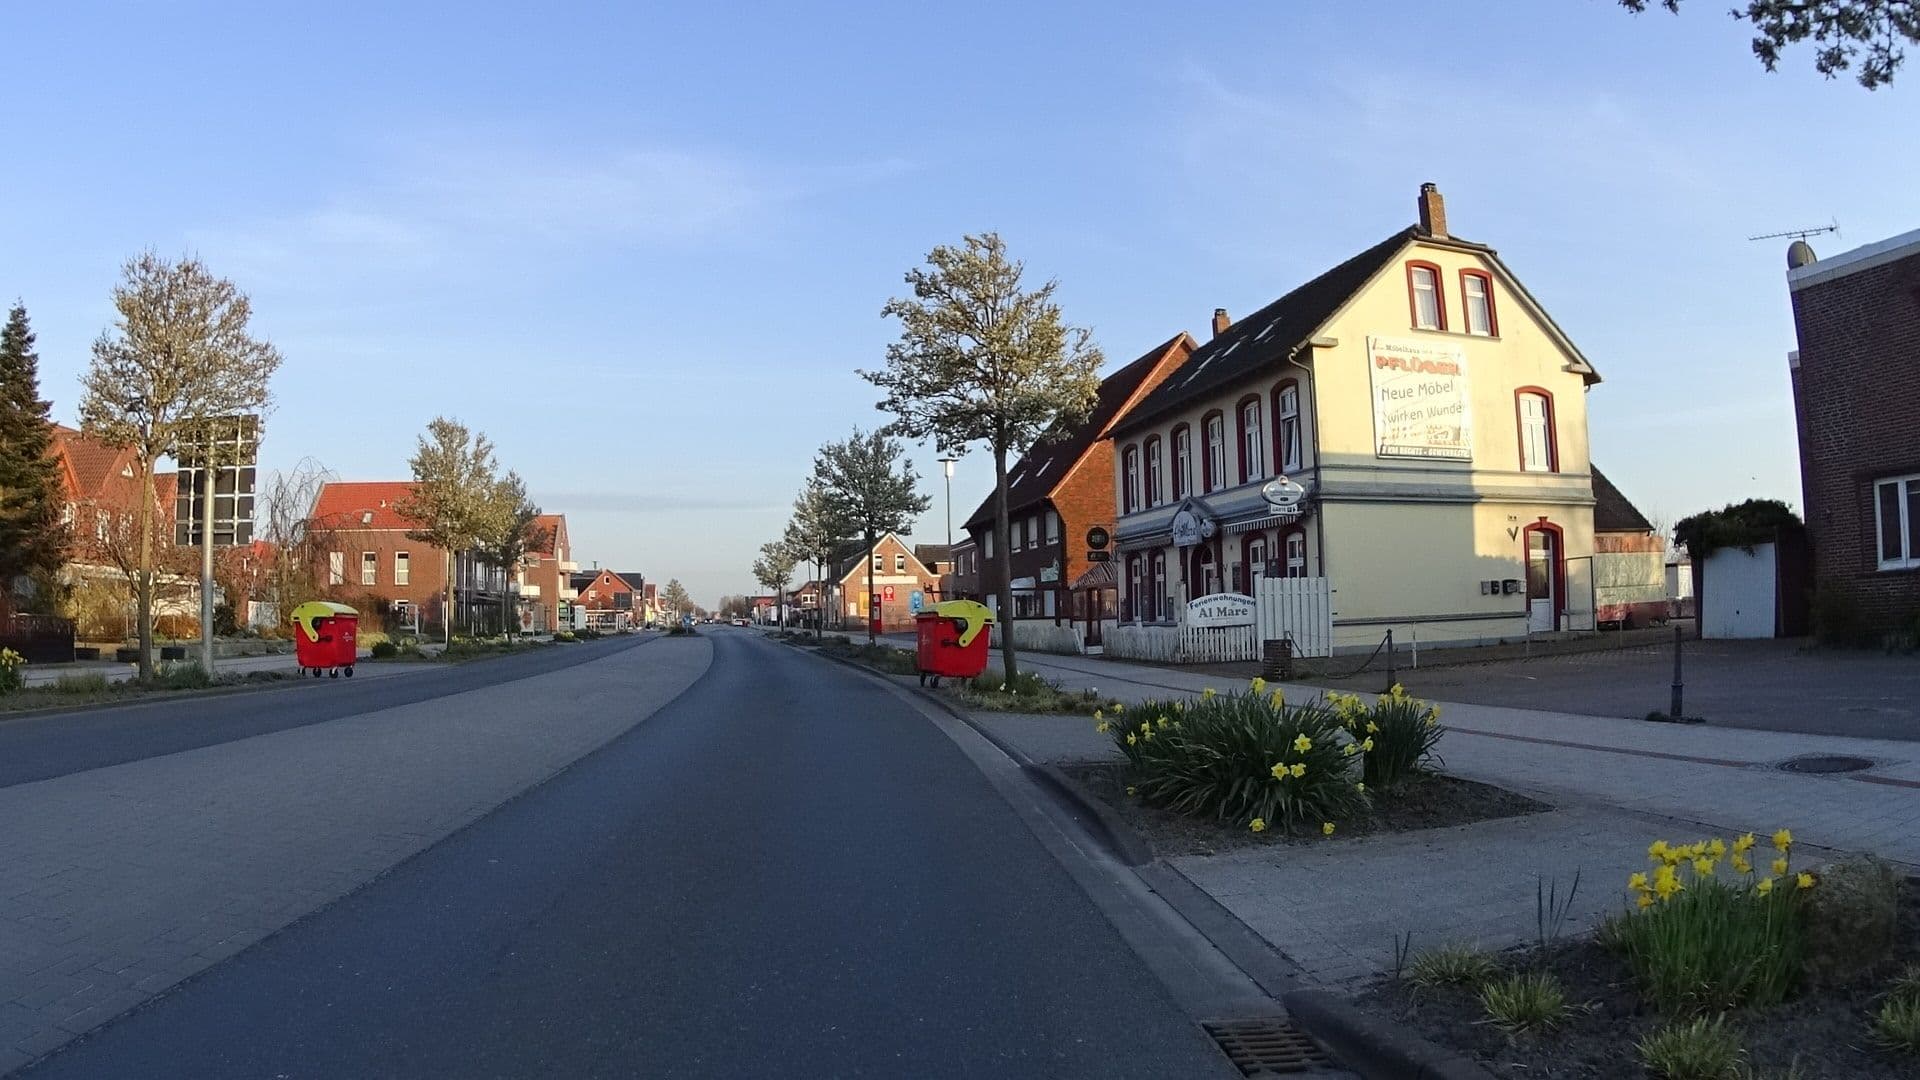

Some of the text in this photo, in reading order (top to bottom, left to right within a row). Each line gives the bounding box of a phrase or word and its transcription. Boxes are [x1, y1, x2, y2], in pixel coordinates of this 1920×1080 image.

[1381, 379, 1454, 401] Neue Möbel
[1387, 409, 1424, 424] wirken
[1189, 595, 1256, 609] Ferienwohnungen
[1198, 606, 1248, 618] Al Mare
